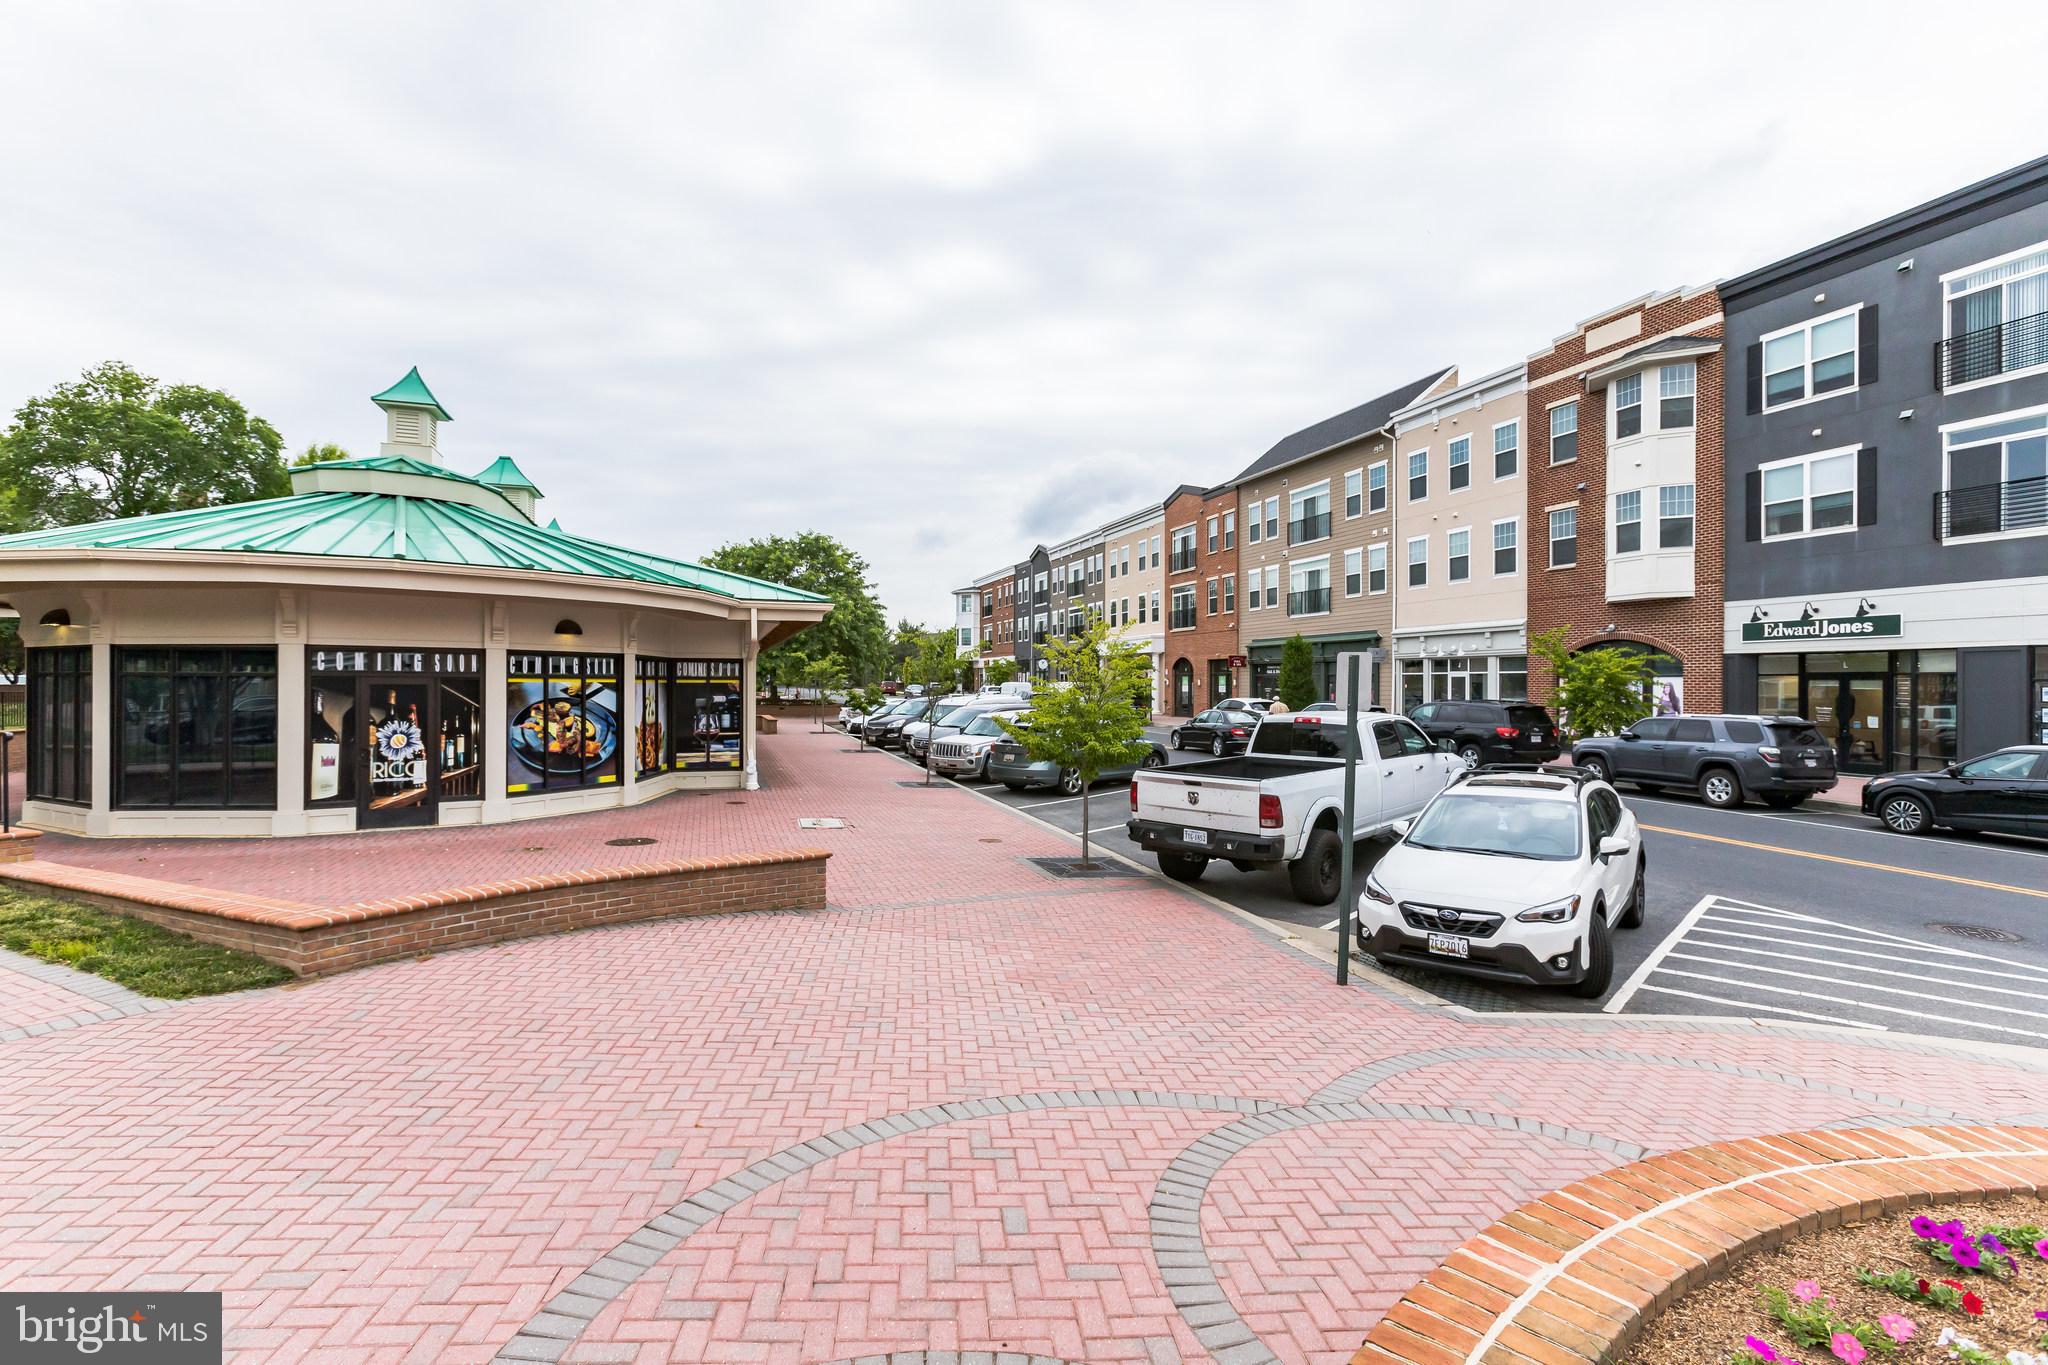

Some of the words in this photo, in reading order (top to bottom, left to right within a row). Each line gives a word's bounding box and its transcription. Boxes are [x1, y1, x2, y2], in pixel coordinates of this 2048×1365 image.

[317, 651, 422, 672] COMING
[434, 653, 477, 673] SOON
[509, 655, 579, 675] COMING
[710, 662, 739, 677] SOON
